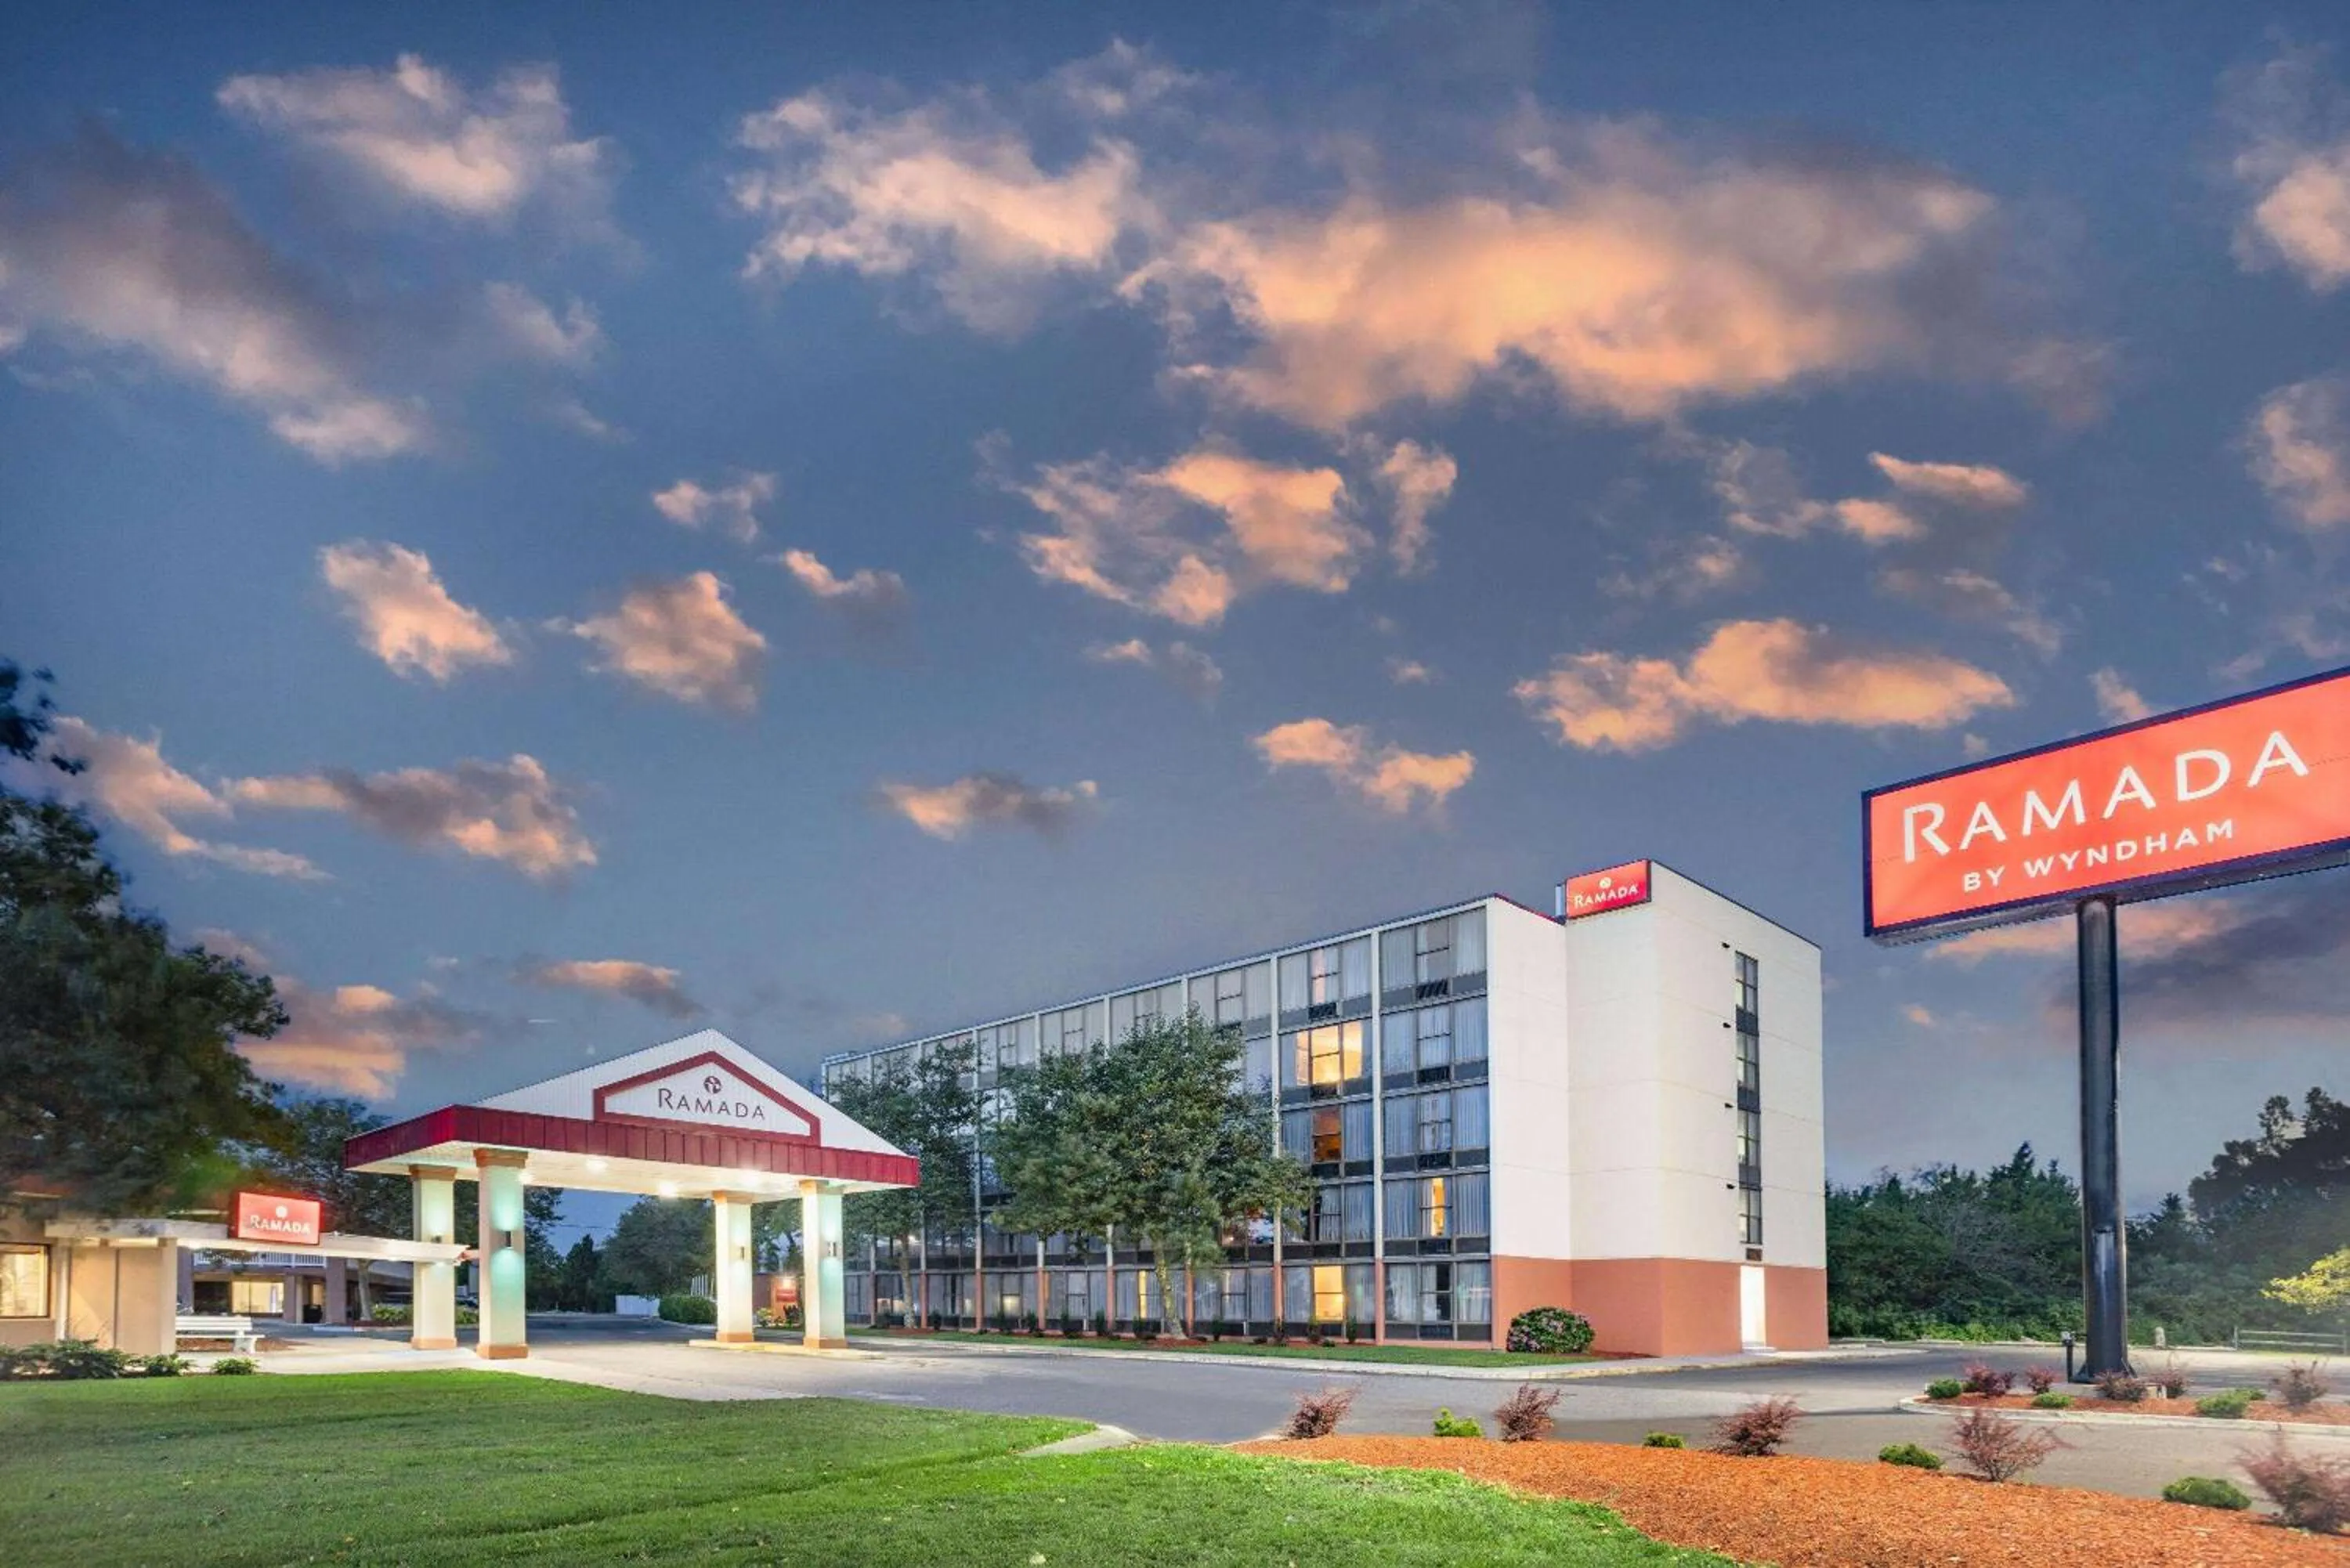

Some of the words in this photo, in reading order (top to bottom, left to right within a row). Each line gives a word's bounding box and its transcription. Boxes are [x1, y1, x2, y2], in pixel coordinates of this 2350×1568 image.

[1904, 731, 2309, 862] RAMADA
[1963, 865, 2006, 893] BY
[2023, 818, 2234, 879] WYNDHAM
[1574, 884, 1638, 908] RAMADA
[658, 1088, 765, 1120] RAMADA
[250, 1215, 311, 1234] RAMADA
